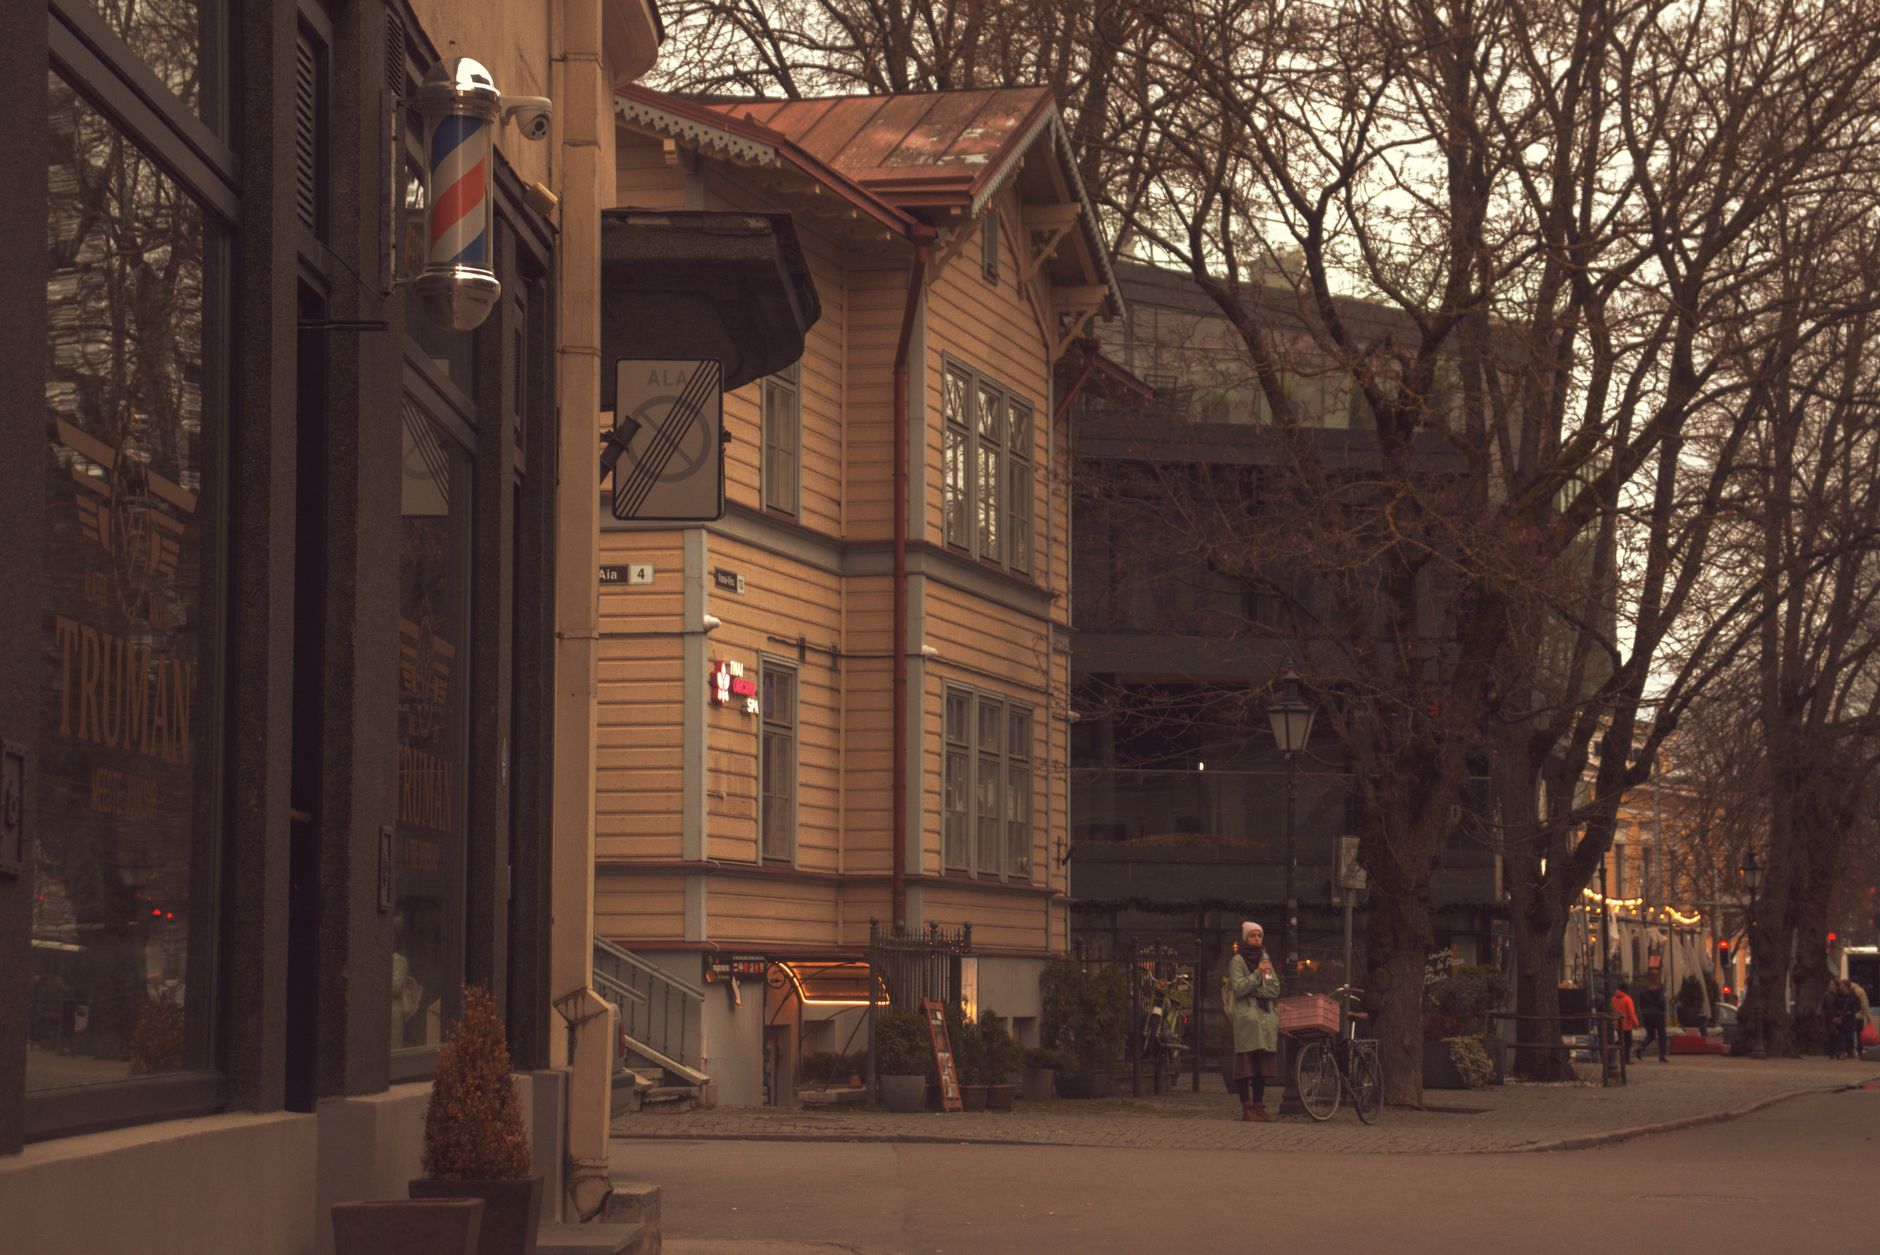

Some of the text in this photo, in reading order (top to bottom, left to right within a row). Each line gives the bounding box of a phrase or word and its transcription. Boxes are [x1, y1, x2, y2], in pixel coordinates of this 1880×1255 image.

[648, 369, 689, 387] ALA
[600, 568, 645, 580] Aia 4
[730, 660, 744, 677] THAI
[55, 614, 193, 767] TRUMAN
[746, 698, 759, 714] SPA
